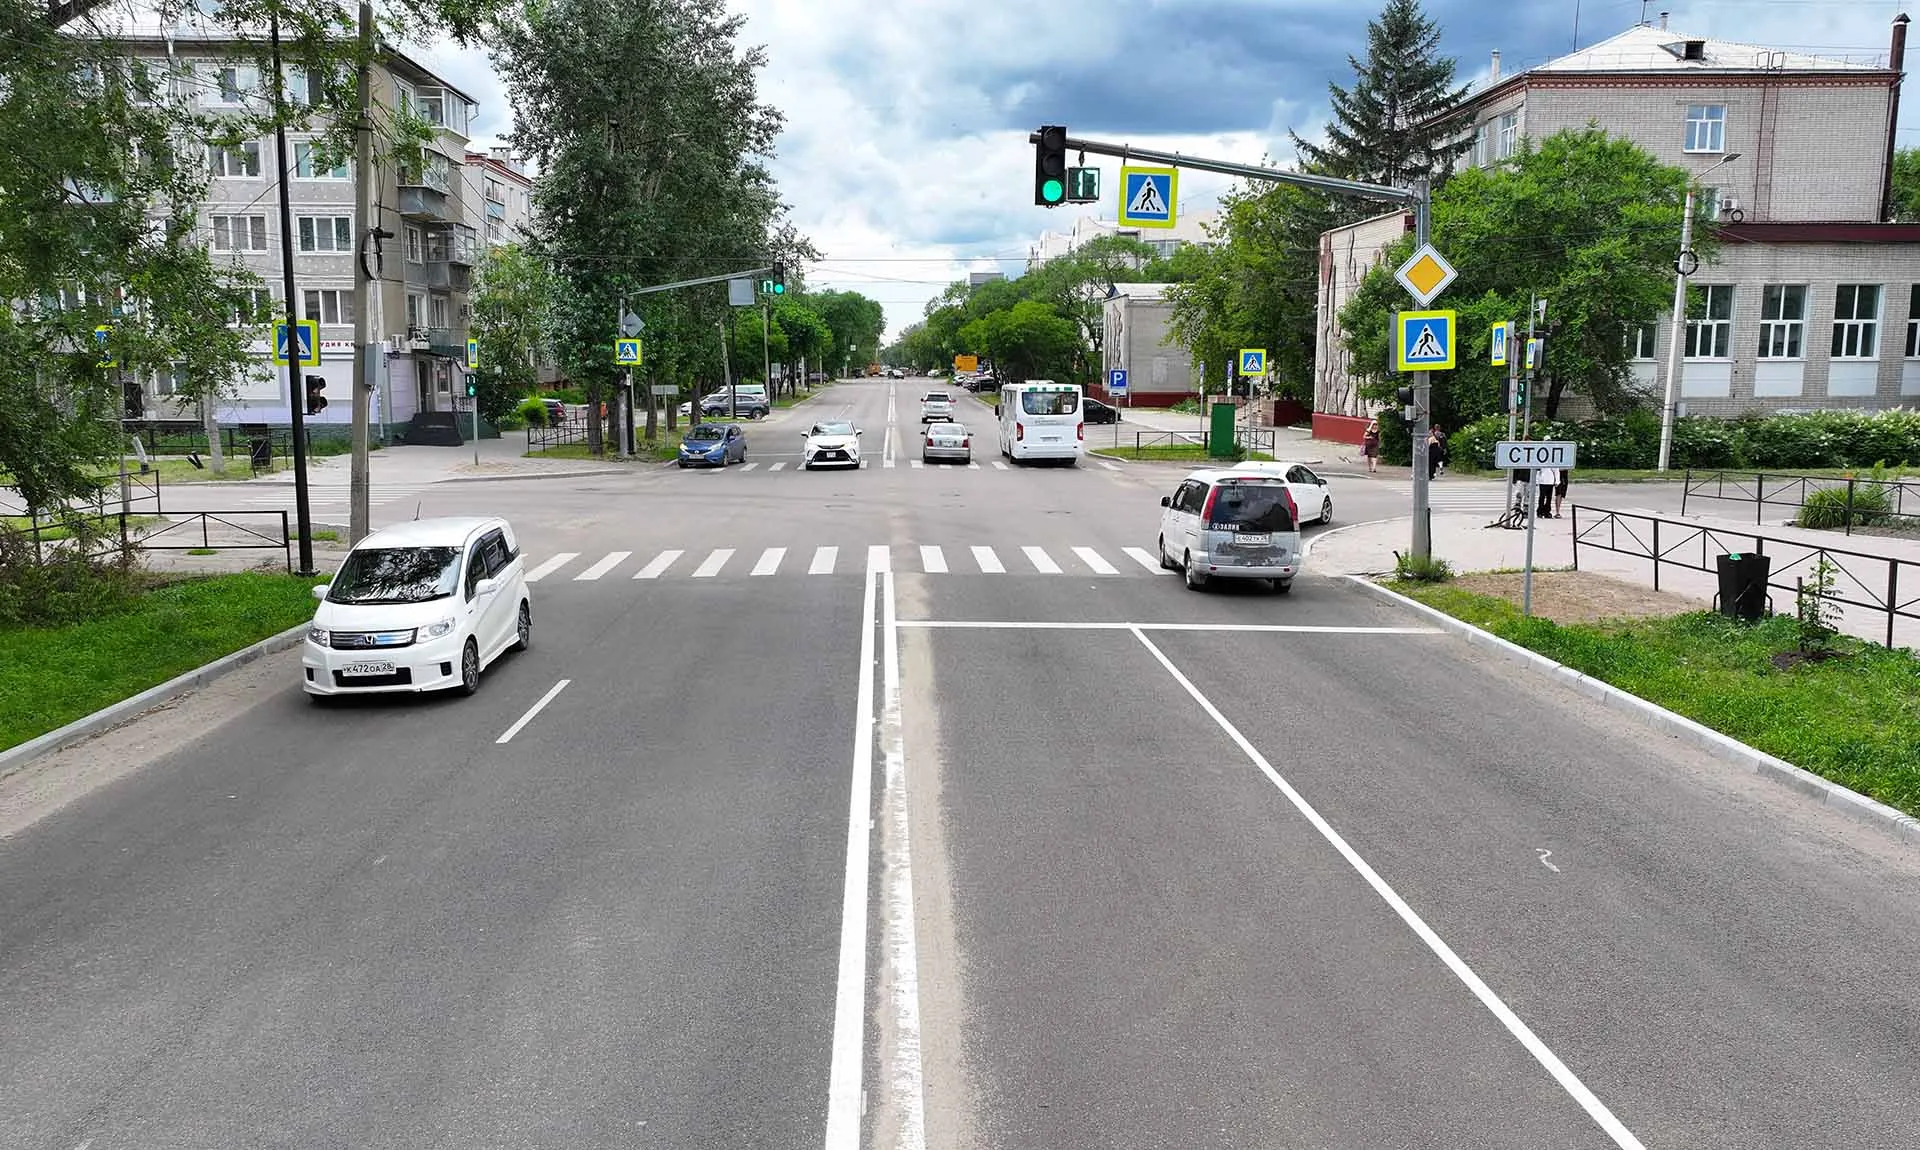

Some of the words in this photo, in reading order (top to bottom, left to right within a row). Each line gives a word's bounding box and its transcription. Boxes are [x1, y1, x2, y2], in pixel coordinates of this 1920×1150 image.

[1078, 169, 1099, 199] 17
[763, 280, 774, 293] 17
[1113, 372, 1123, 385] P
[1509, 447, 1564, 463] СТОП
